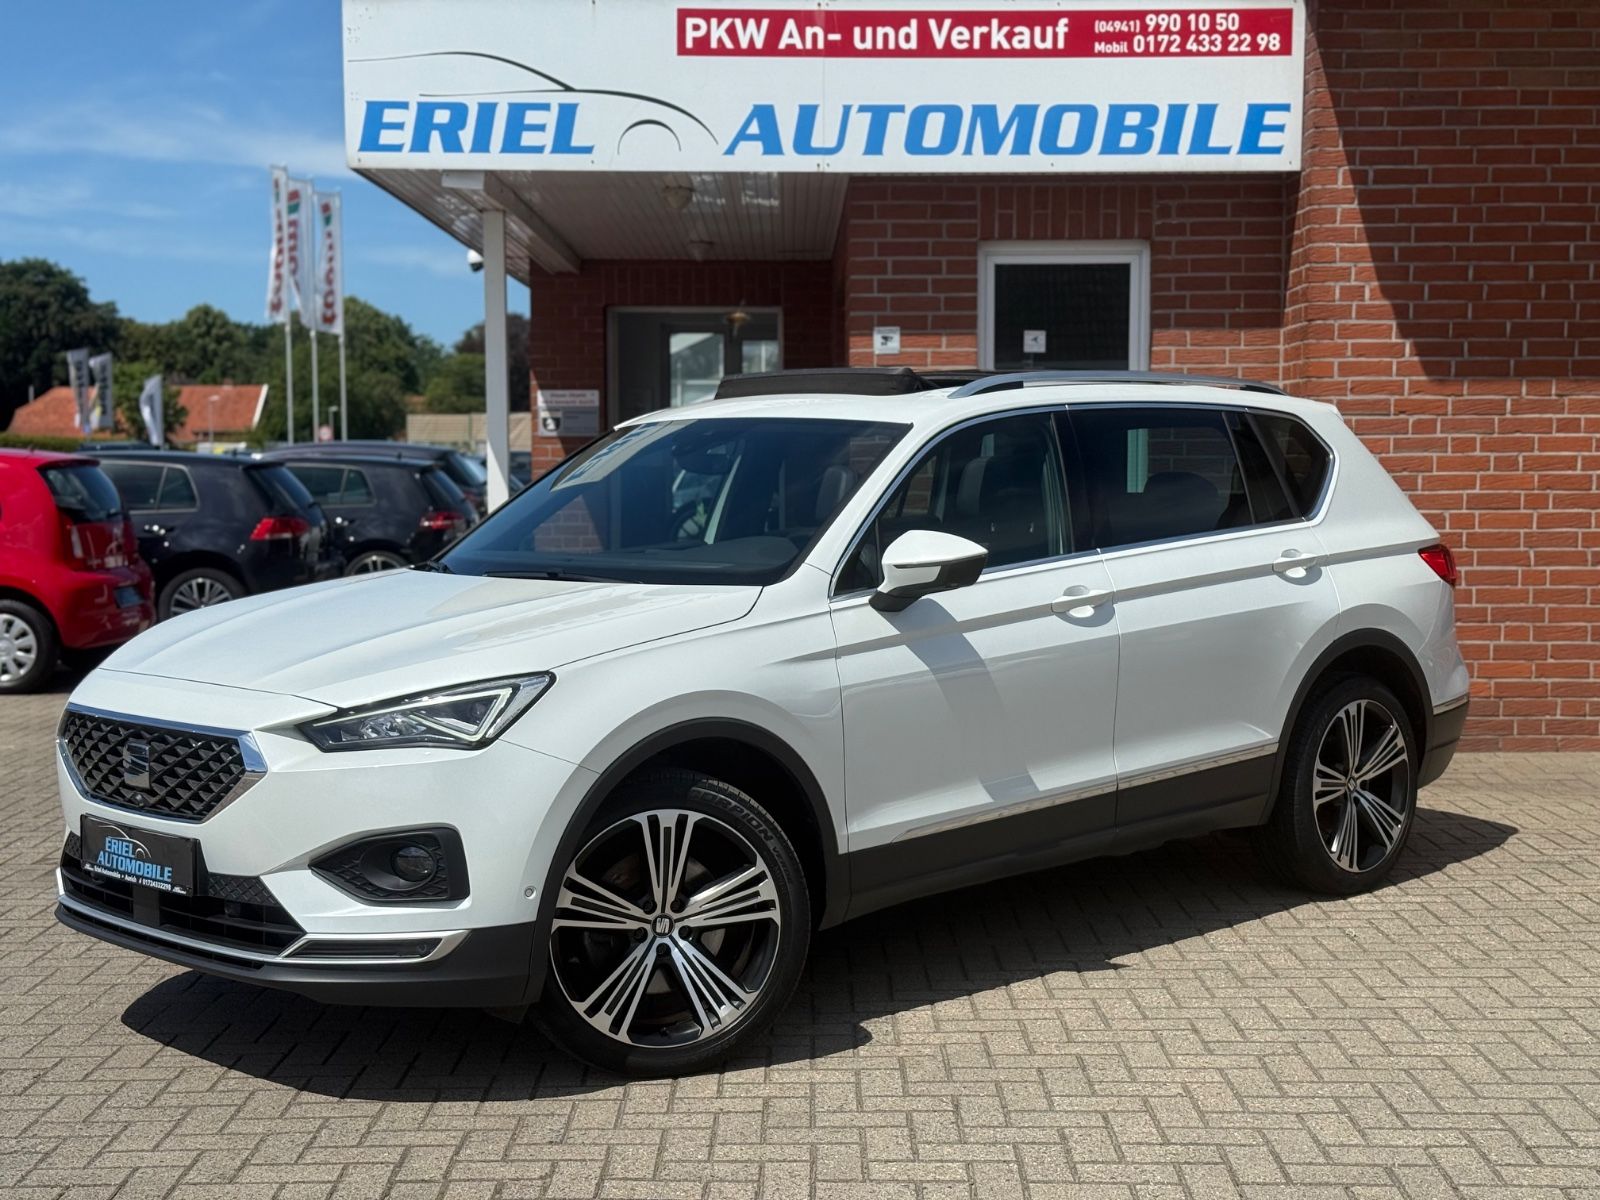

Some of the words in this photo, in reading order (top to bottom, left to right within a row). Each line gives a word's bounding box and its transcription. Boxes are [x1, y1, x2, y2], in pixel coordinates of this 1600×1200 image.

[684, 17, 769, 50] PKW
[777, 17, 843, 50] An-
[852, 17, 919, 51] und
[927, 17, 1070, 51] Verkauf
[1094, 20, 1140, 34] (04941)
[1145, 13, 1181, 32] 990
[1187, 13, 1210, 31] 10
[1215, 13, 1240, 31] 50
[1094, 41, 1128, 54] Mobil
[1133, 34, 1181, 53] 0172
[1186, 34, 1222, 53] 433
[1227, 33, 1251, 52] 22
[1256, 33, 1281, 51] 98
[358, 100, 596, 156] ERIEL
[724, 102, 1292, 157] AUTOMOBILE
[676, 789, 774, 841] CORPION
[105, 836, 135, 858] ERIEL
[97, 850, 173, 882] AUTOMOBILE
